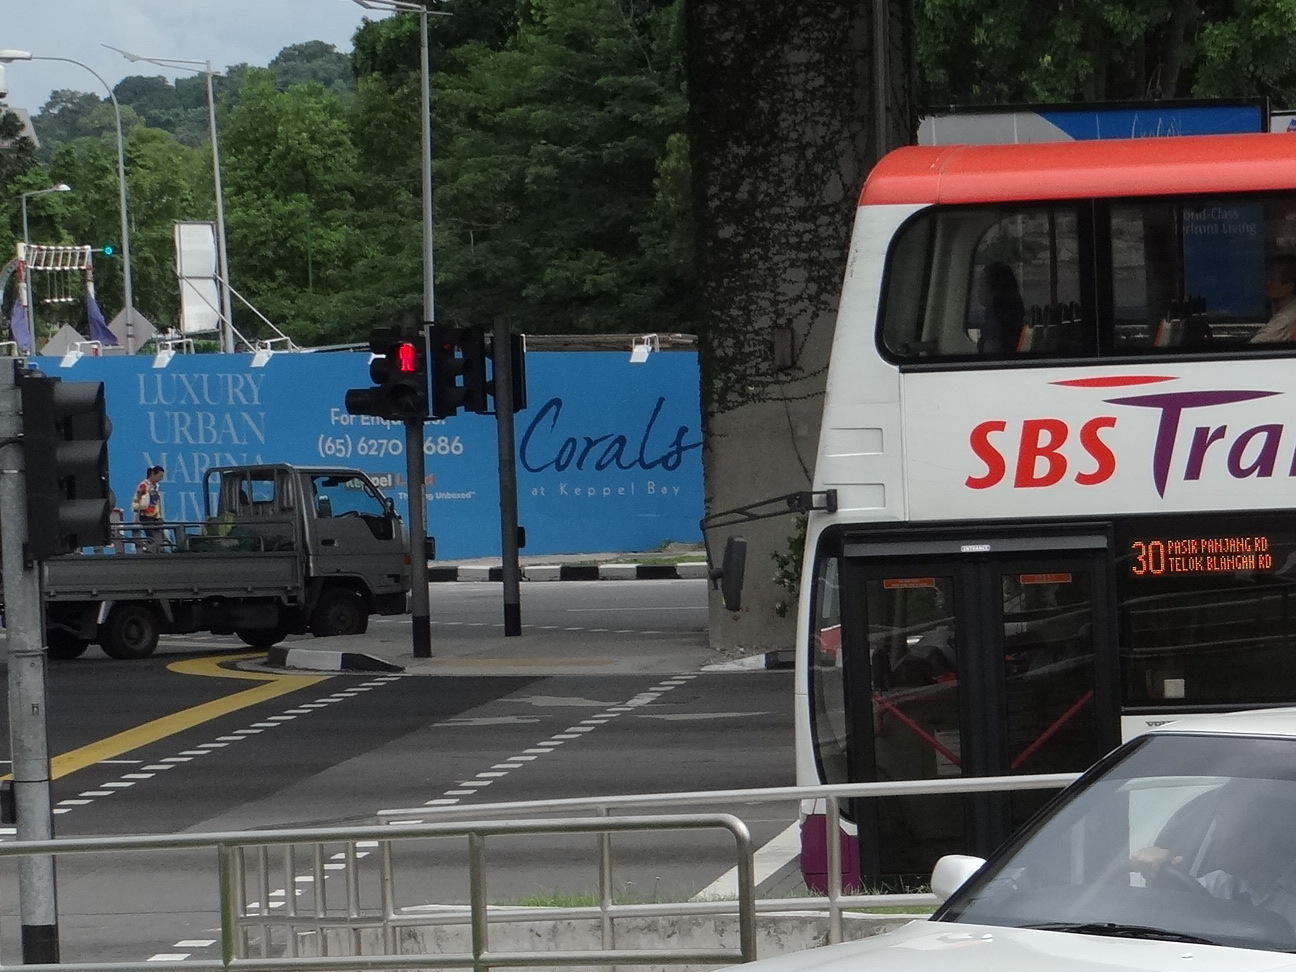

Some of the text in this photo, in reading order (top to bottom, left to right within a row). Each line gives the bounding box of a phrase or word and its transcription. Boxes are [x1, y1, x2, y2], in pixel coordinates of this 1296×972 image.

[137, 373, 266, 405] LUXURY
[147, 411, 266, 444] URBAN
[331, 408, 356, 425] For
[318, 434, 464, 458] (65) 6270 686
[519, 396, 703, 473] Corals
[965, 416, 1117, 489] SBS
[531, 481, 680, 498] at Keppel Bay
[1131, 540, 1165, 575] 30
[1167, 536, 1268, 554] PASIR PANJANG RD
[1168, 554, 1272, 572] TELOK BLANGAH RD
